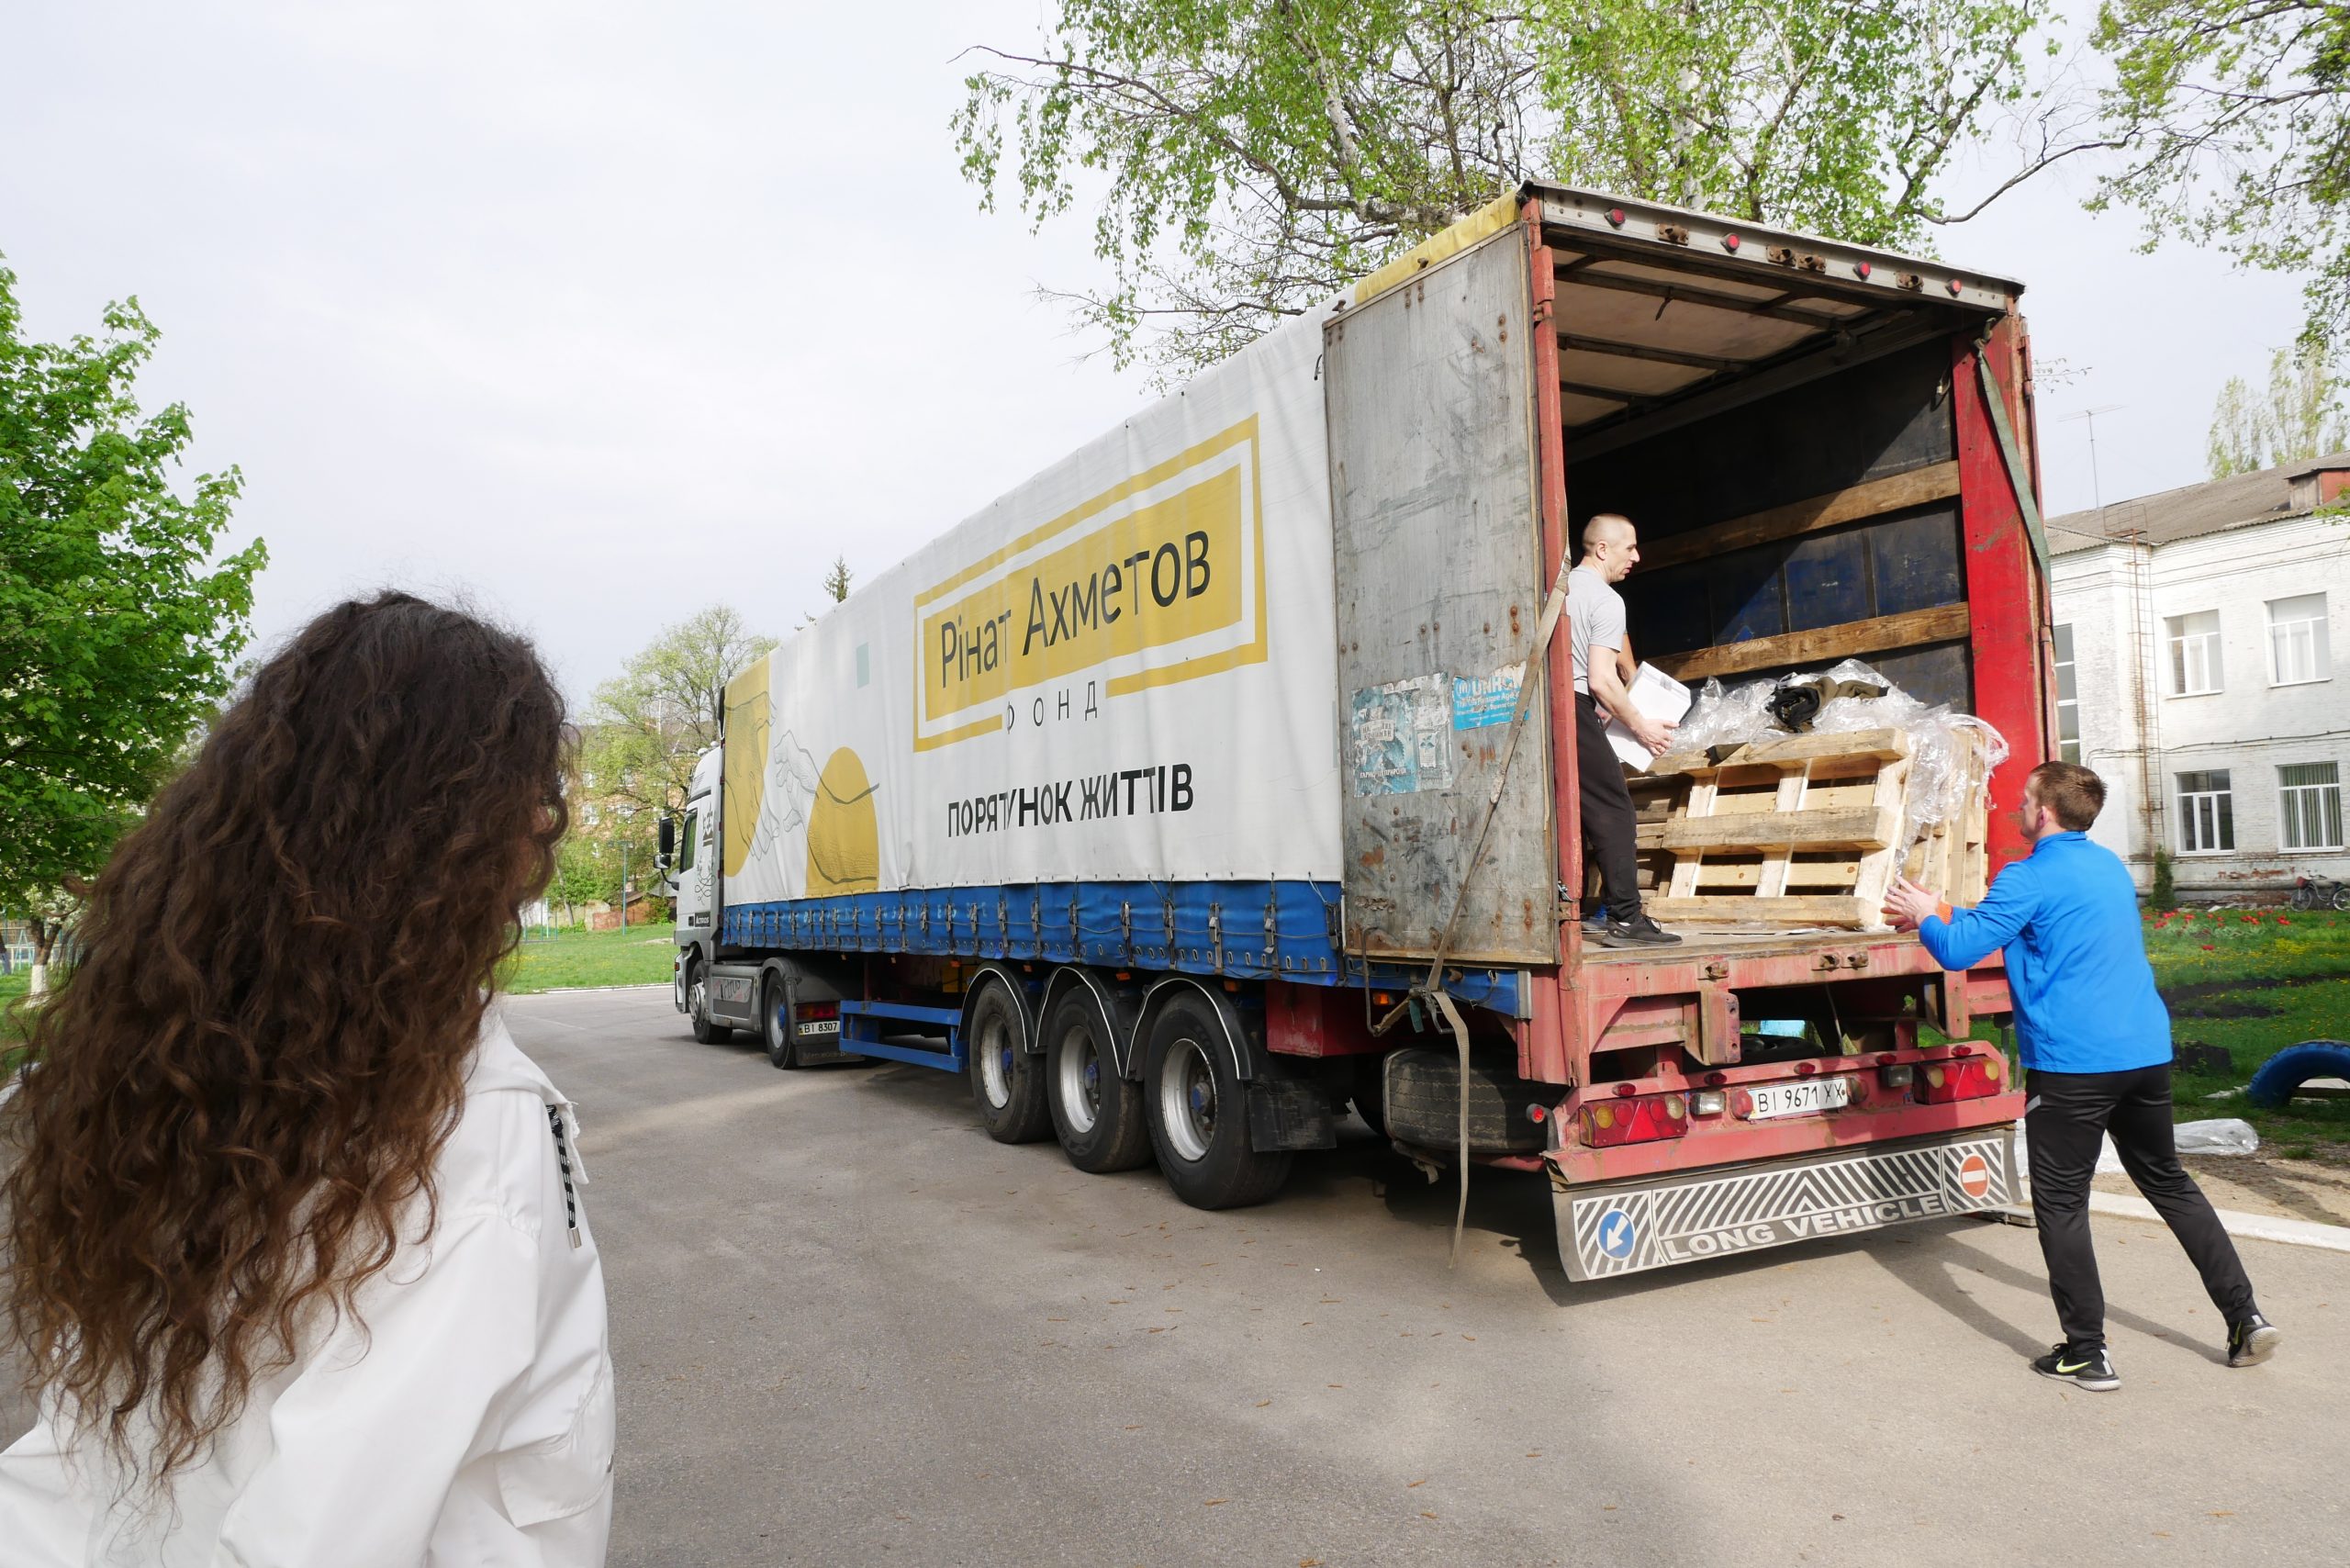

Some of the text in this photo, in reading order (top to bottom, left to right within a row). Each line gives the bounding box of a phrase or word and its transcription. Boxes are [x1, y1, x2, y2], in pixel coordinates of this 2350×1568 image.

[941, 530, 1211, 689] Рінат Ахметов
[947, 763, 1194, 837] ПОРЯТУНОК ЖИТТІВ
[818, 1022, 837, 1032] 8307
[1785, 1085, 1818, 1110] 9671
[1823, 1082, 1843, 1103] XX
[1661, 1193, 1944, 1260] LONG VEHICLE
